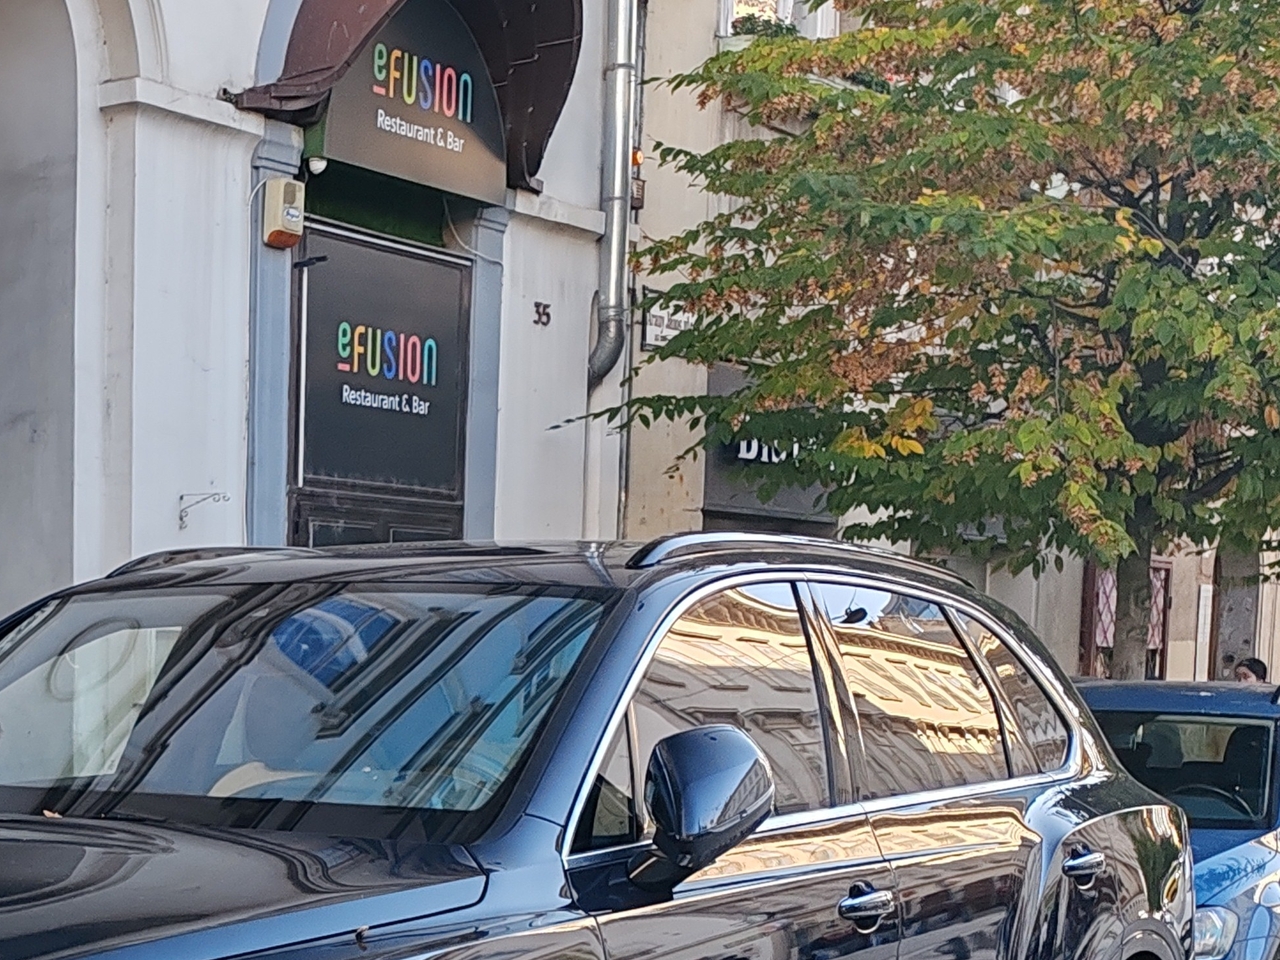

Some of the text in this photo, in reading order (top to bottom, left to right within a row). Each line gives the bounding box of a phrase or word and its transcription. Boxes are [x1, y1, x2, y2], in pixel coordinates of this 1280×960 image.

[377, 109, 465, 152] Restaurant & Bar
[533, 301, 551, 327] 35
[342, 384, 430, 415] Restaurant & Bar
